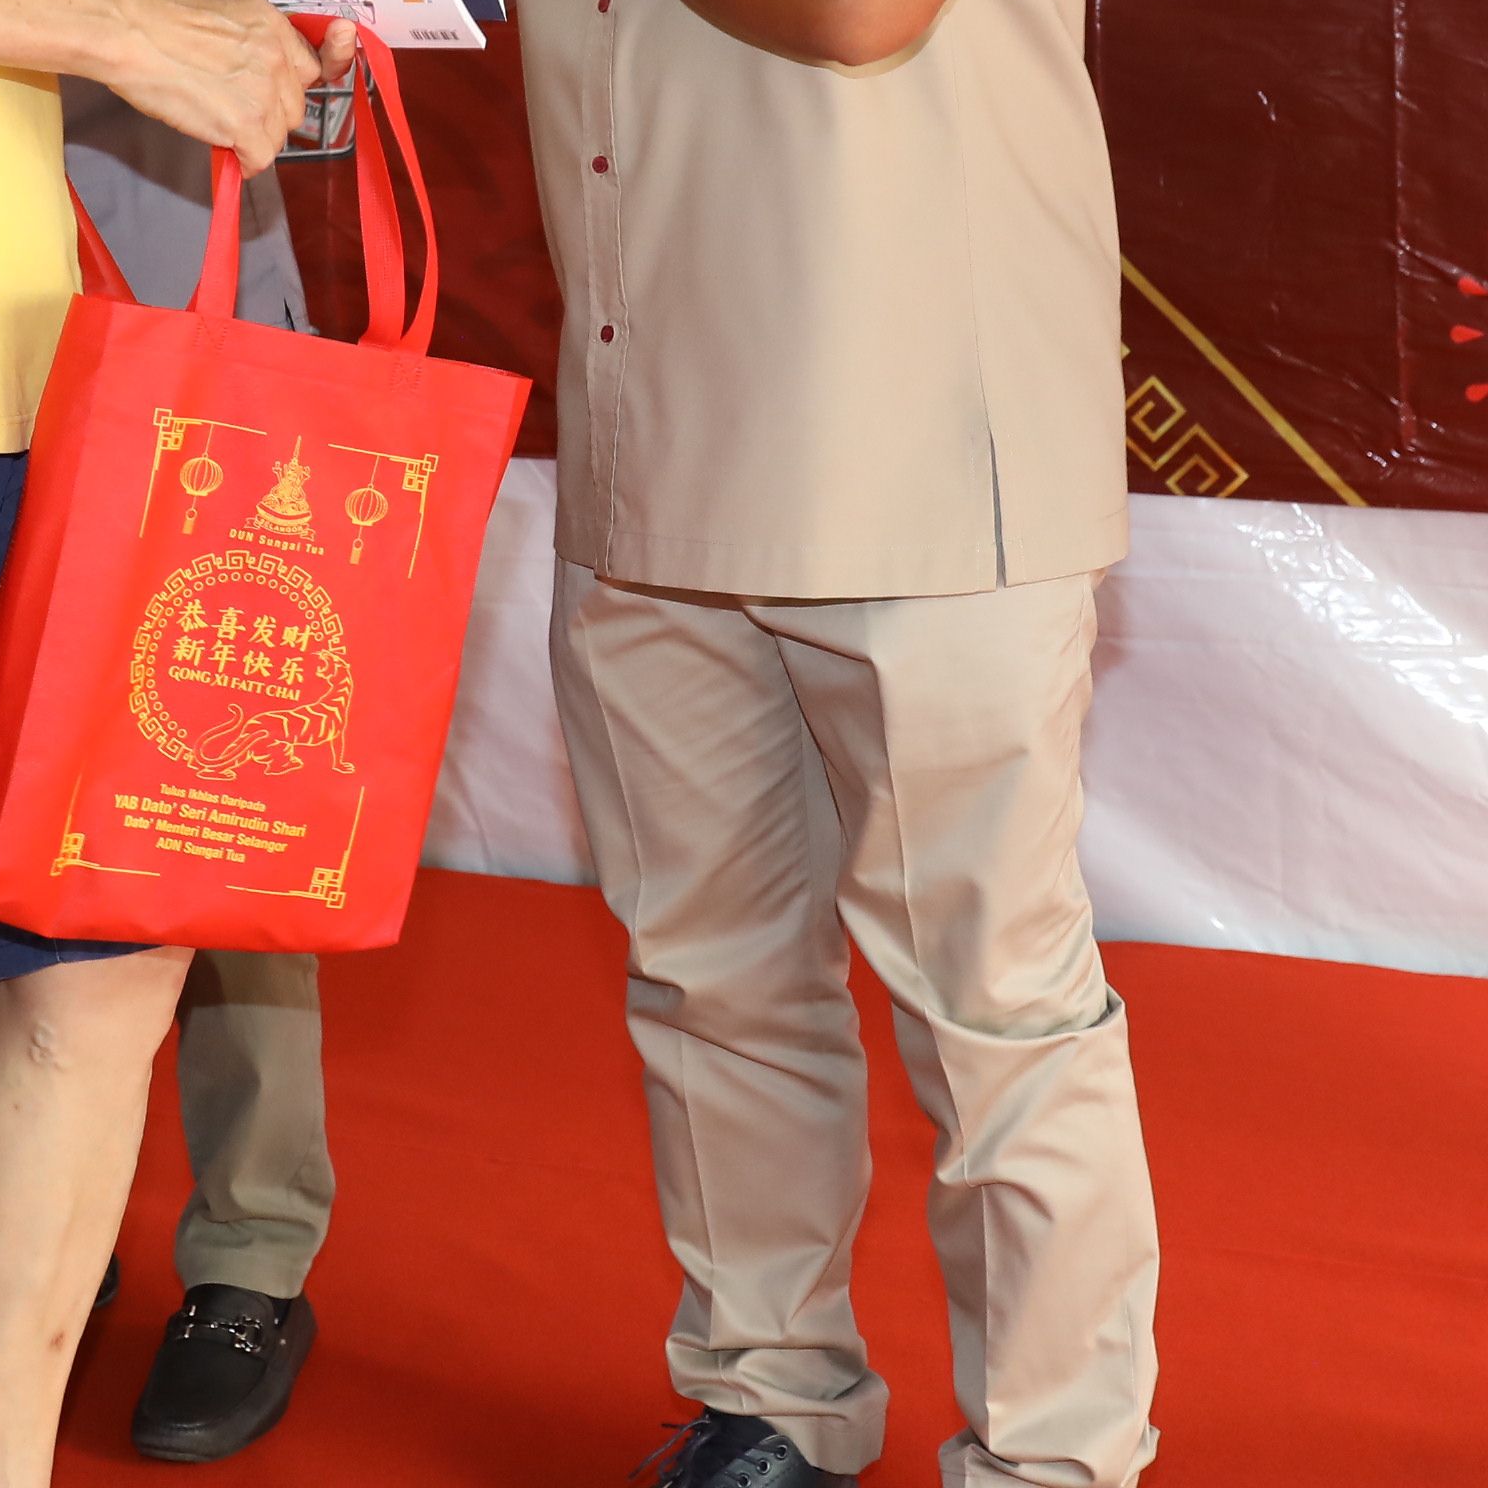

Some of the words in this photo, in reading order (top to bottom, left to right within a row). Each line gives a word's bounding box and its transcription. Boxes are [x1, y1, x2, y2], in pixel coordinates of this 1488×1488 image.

[229, 528, 254, 542] DUN
[258, 535, 301, 552] Sungai
[306, 543, 324, 555] Tua
[176, 599, 315, 652] 恭喜发财
[172, 636, 304, 685] 新年快乐
[168, 665, 212, 683] GONG
[210, 673, 229, 687] XI
[231, 677, 266, 694] FATT
[266, 684, 301, 701] CHAI
[160, 783, 186, 798] Tulus
[188, 788, 220, 804] Ikhlas
[221, 794, 267, 812] Daripada
[114, 794, 139, 810] YAB
[179, 803, 207, 821] Seri
[208, 809, 270, 832] Amirudin
[272, 820, 308, 837] Shari
[155, 818, 200, 838] Menteri
[202, 827, 236, 843] Besar
[237, 833, 289, 853] Selangor
[156, 837, 183, 852] ADN
[183, 842, 224, 860] Sungai
[225, 848, 246, 863] Tua
